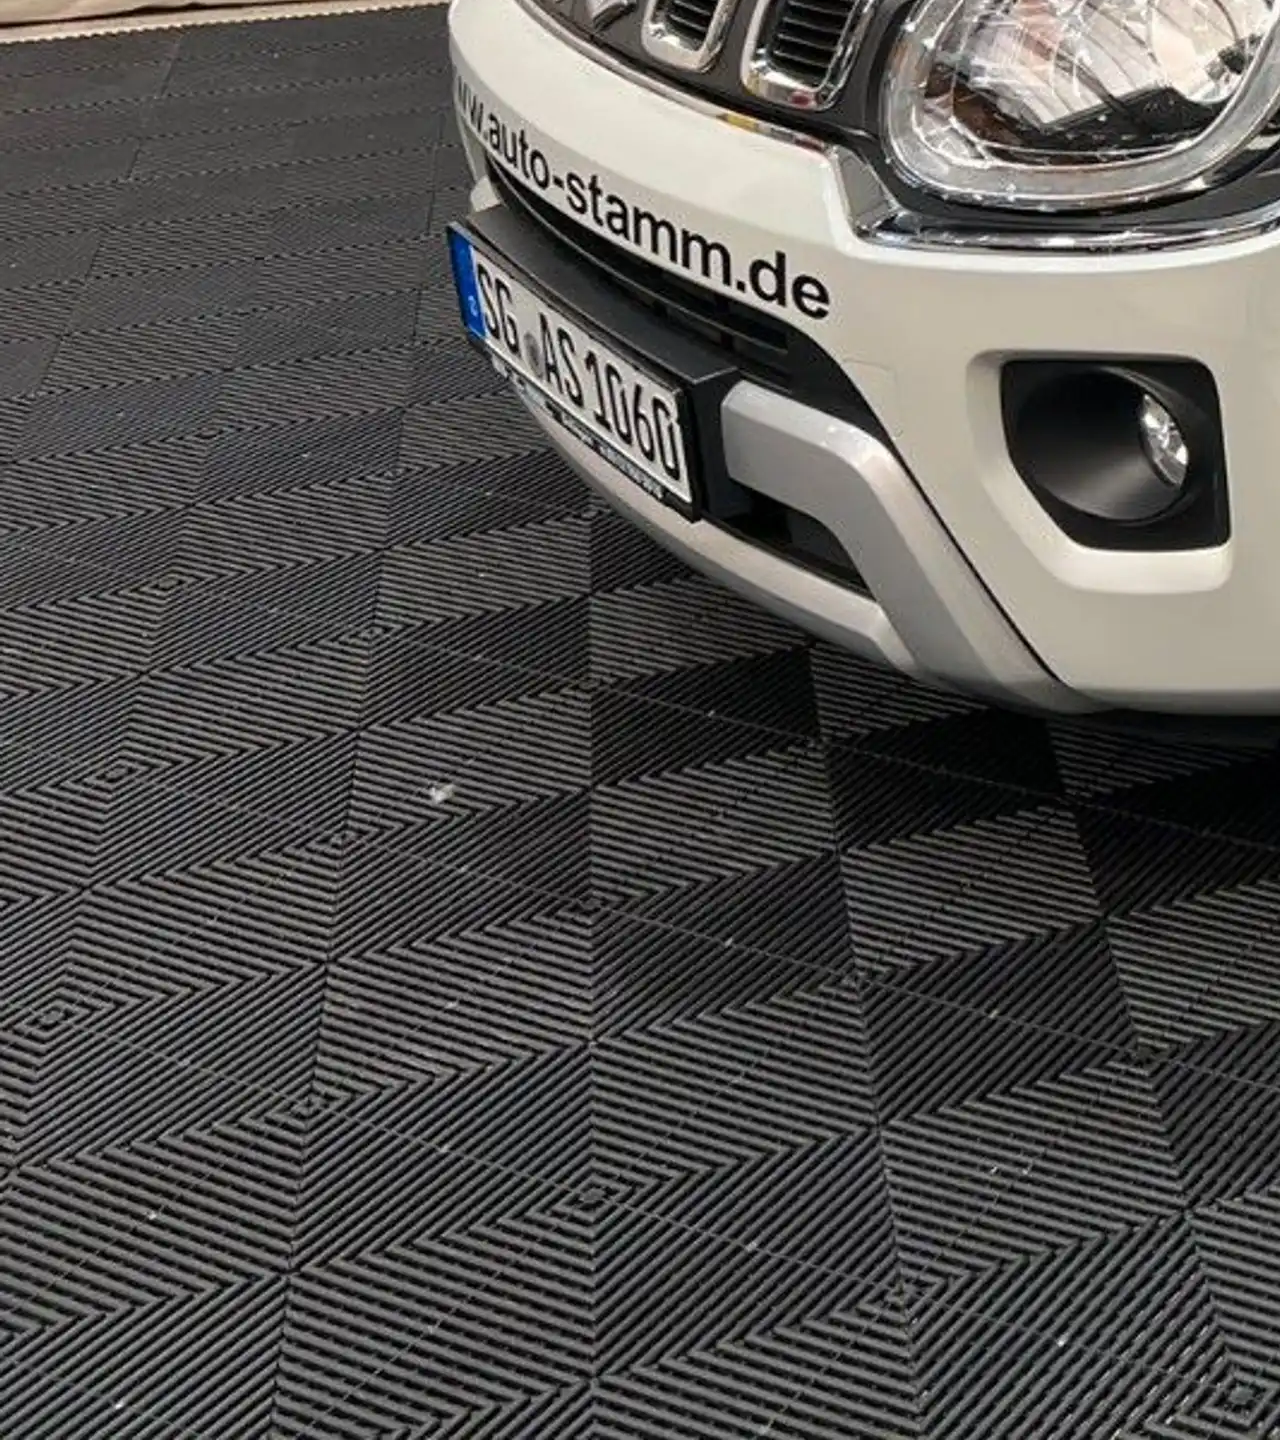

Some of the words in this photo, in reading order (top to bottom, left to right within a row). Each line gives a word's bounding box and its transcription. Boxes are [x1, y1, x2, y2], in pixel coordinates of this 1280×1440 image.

[476, 262, 522, 359] SG
[539, 311, 586, 410] AS
[584, 349, 682, 482] 1060
